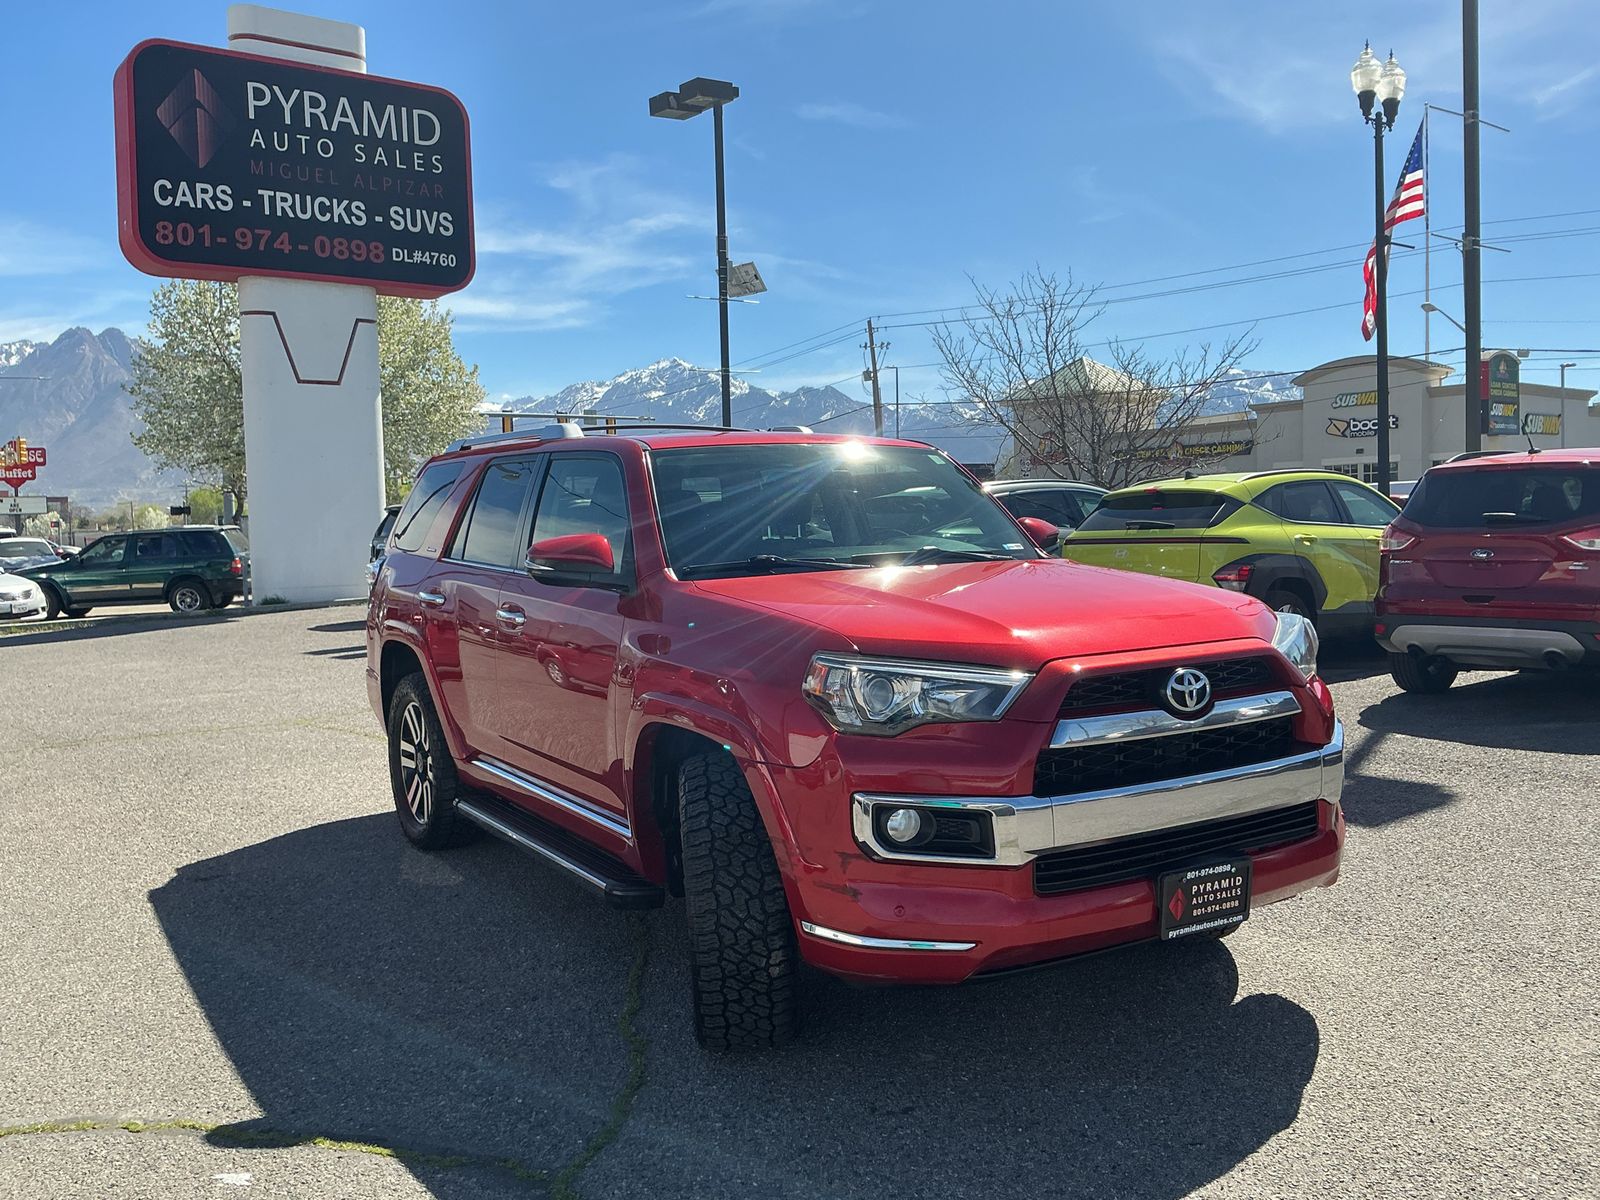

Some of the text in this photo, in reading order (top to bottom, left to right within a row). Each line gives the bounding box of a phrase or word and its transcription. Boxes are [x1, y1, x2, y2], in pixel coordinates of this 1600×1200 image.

[246, 81, 441, 146] PYRAMID
[249, 128, 443, 174] AUTO SALES
[250, 159, 446, 200] MIGUEL ALPIZAR
[153, 179, 233, 212] CARS
[257, 189, 367, 227] TRUCKS
[389, 206, 455, 237] SUVS
[392, 247, 457, 268] DL#4760
[1332, 391, 1379, 408] SUBWA
[1490, 403, 1517, 416] SUBWAY
[1350, 415, 1396, 431] boot
[1525, 415, 1561, 433] SUBWAY
[1350, 430, 1375, 438] mobile
[1186, 864, 1232, 880] 801-974-0898
[1191, 876, 1243, 895] PYRAMID
[1191, 887, 1242, 906] AUTO SALES
[1192, 900, 1240, 917] 801-974-0898
[1168, 915, 1243, 939] pyramidautosales.com
